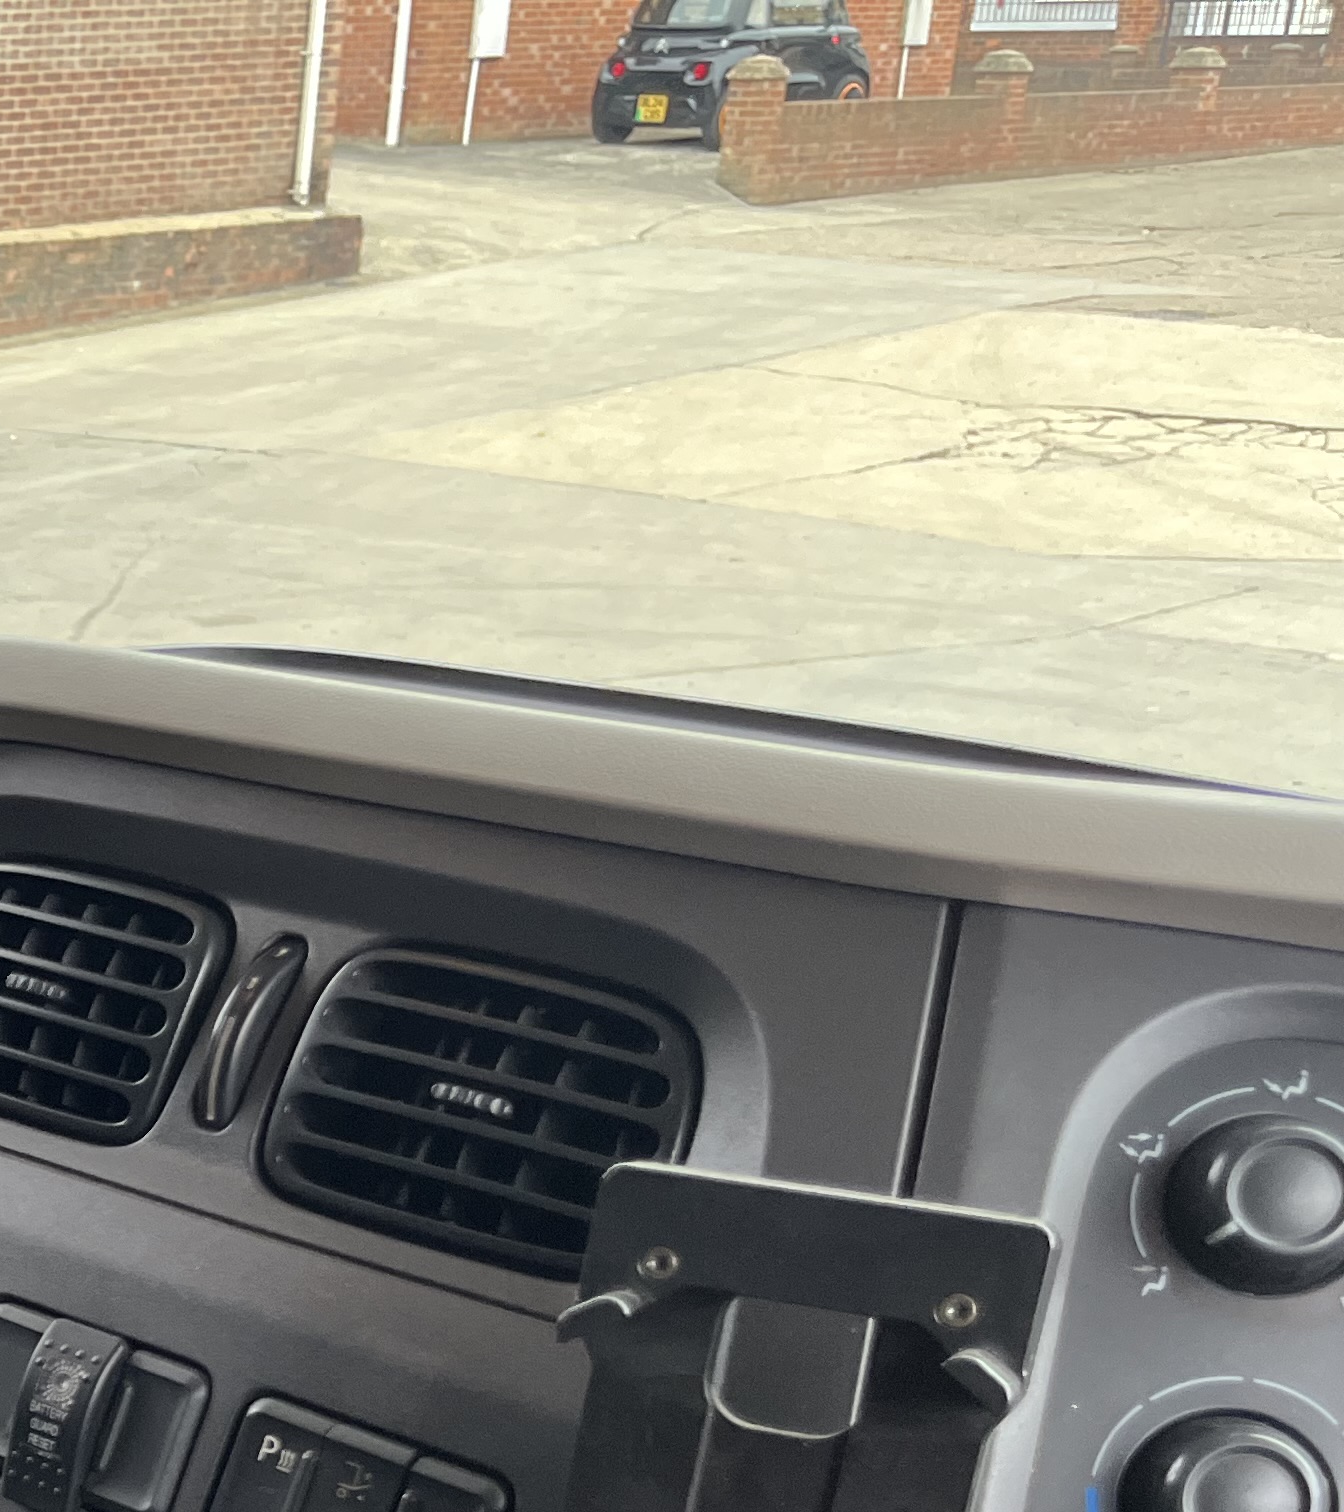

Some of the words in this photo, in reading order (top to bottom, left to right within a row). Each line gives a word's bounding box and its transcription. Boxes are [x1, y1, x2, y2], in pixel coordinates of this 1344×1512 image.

[29, 1399, 69, 1422] BATTERY
[29, 1417, 59, 1437] GUARD
[26, 1432, 56, 1452] RESET
[257, 1434, 282, 1461] P
